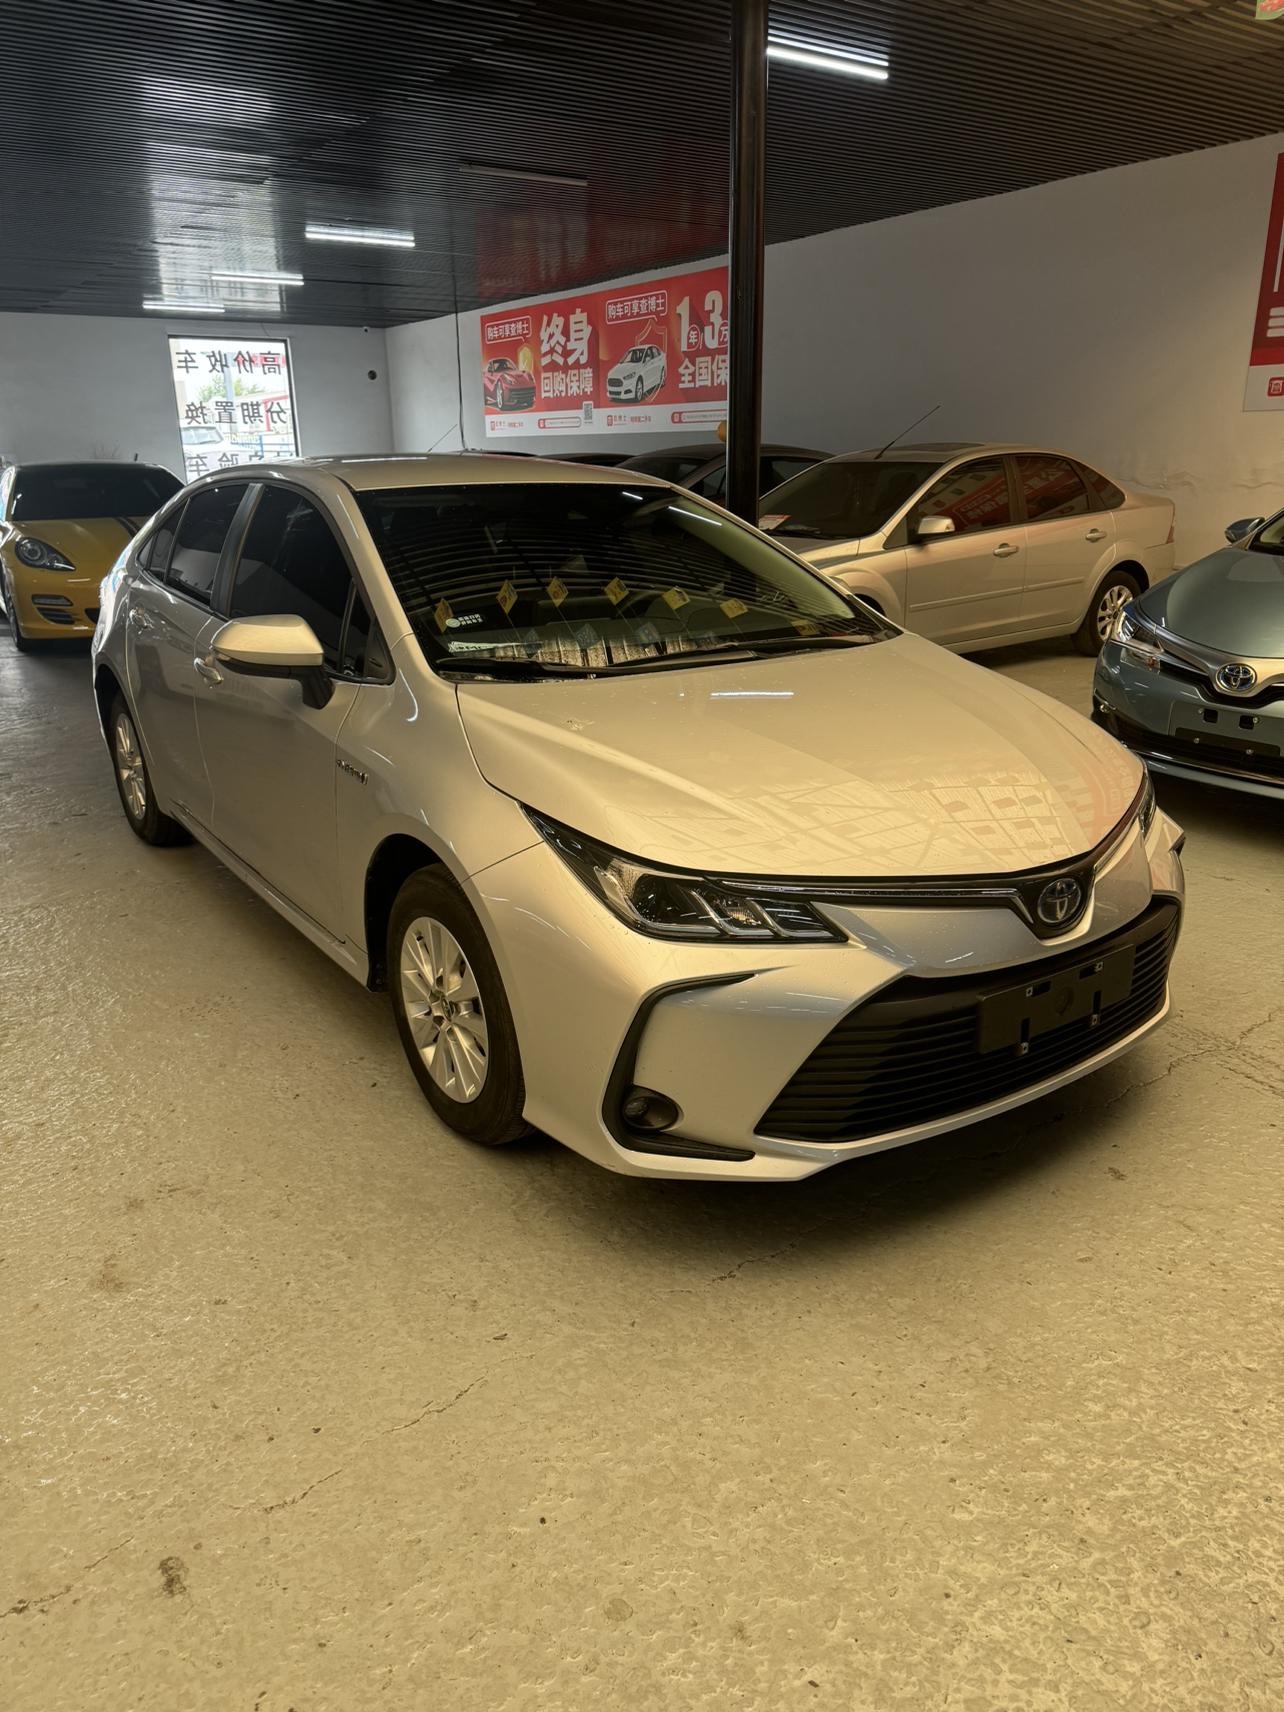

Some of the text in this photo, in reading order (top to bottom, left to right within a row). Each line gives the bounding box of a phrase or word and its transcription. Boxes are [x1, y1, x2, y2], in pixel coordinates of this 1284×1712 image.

[607, 294, 665, 319] 购车可享查博士
[487, 320, 529, 340] 购车可享查博士
[540, 308, 593, 366] 终身
[541, 367, 593, 399] 回购保障
